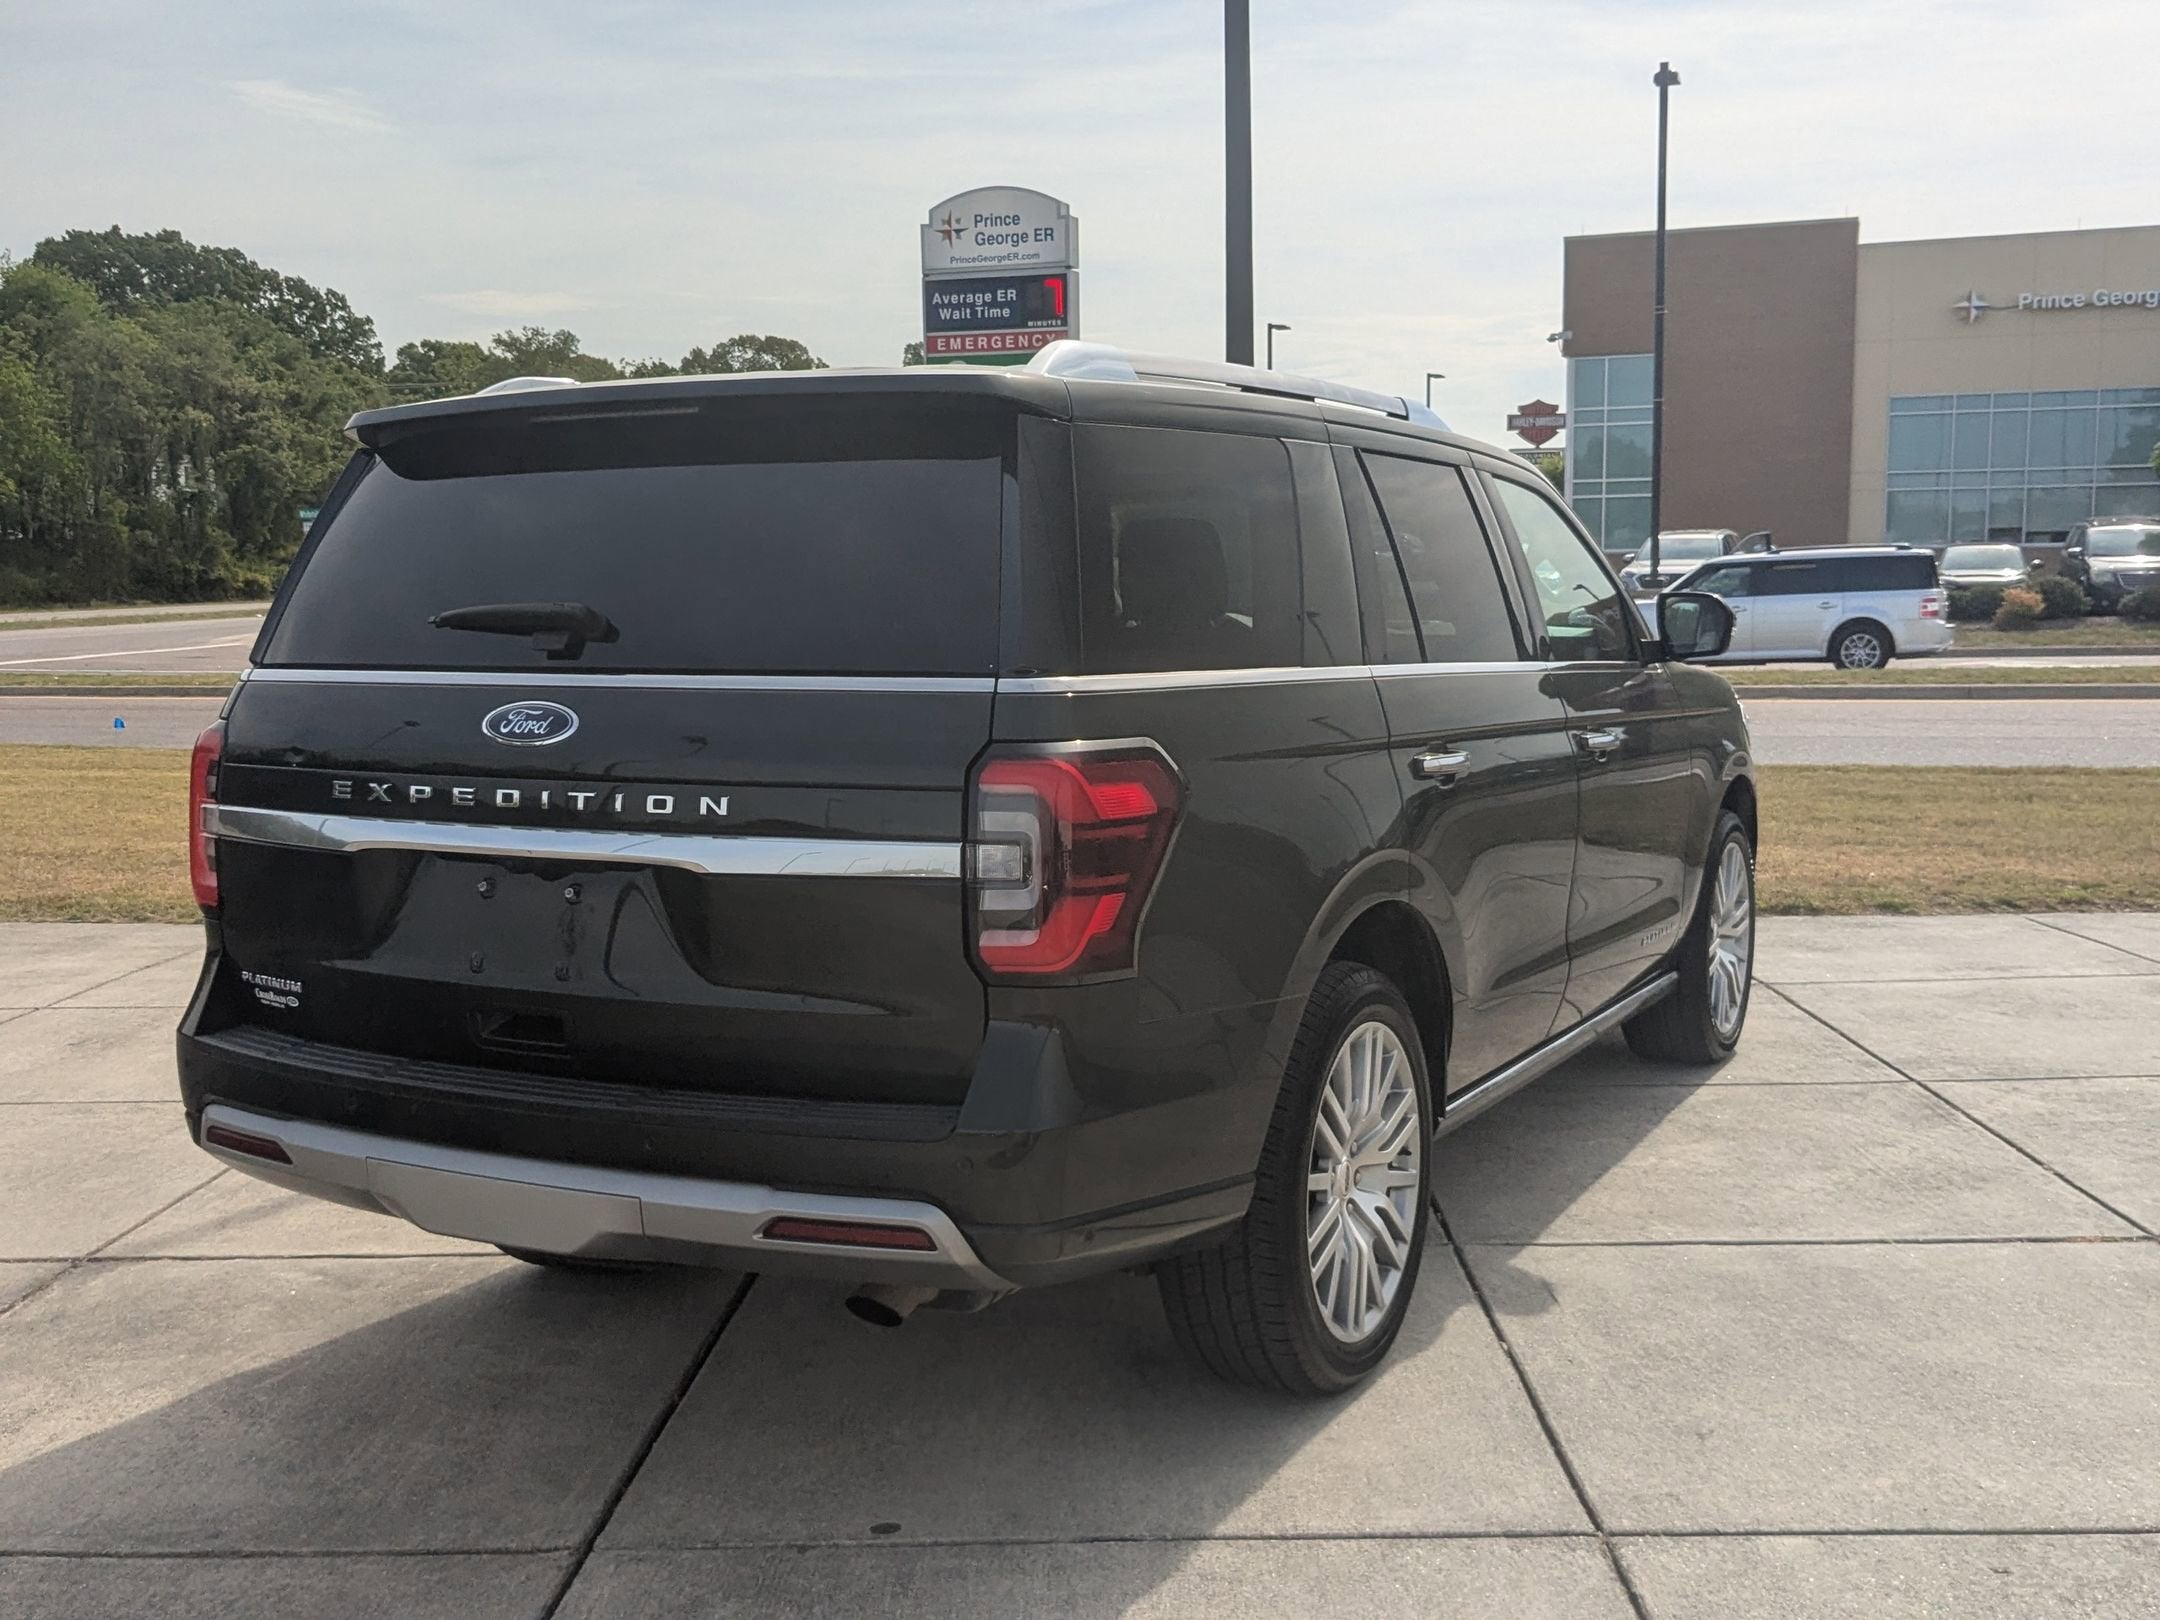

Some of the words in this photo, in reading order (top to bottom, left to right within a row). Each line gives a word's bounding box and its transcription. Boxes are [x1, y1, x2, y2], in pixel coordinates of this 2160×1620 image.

[974, 213, 1021, 229] Prince
[975, 231, 1029, 247] George
[1034, 227, 1054, 242] ER
[950, 252, 1040, 265] PrinceGeorgeER.com
[932, 291, 992, 305] Average
[997, 289, 1017, 302] ER
[2018, 292, 2086, 311] Prince
[939, 308, 971, 321] Wait
[977, 306, 1011, 319] Time
[499, 707, 551, 736] Ford
[331, 779, 731, 817] EXPEDITION
[241, 970, 302, 993] PLATINUM
